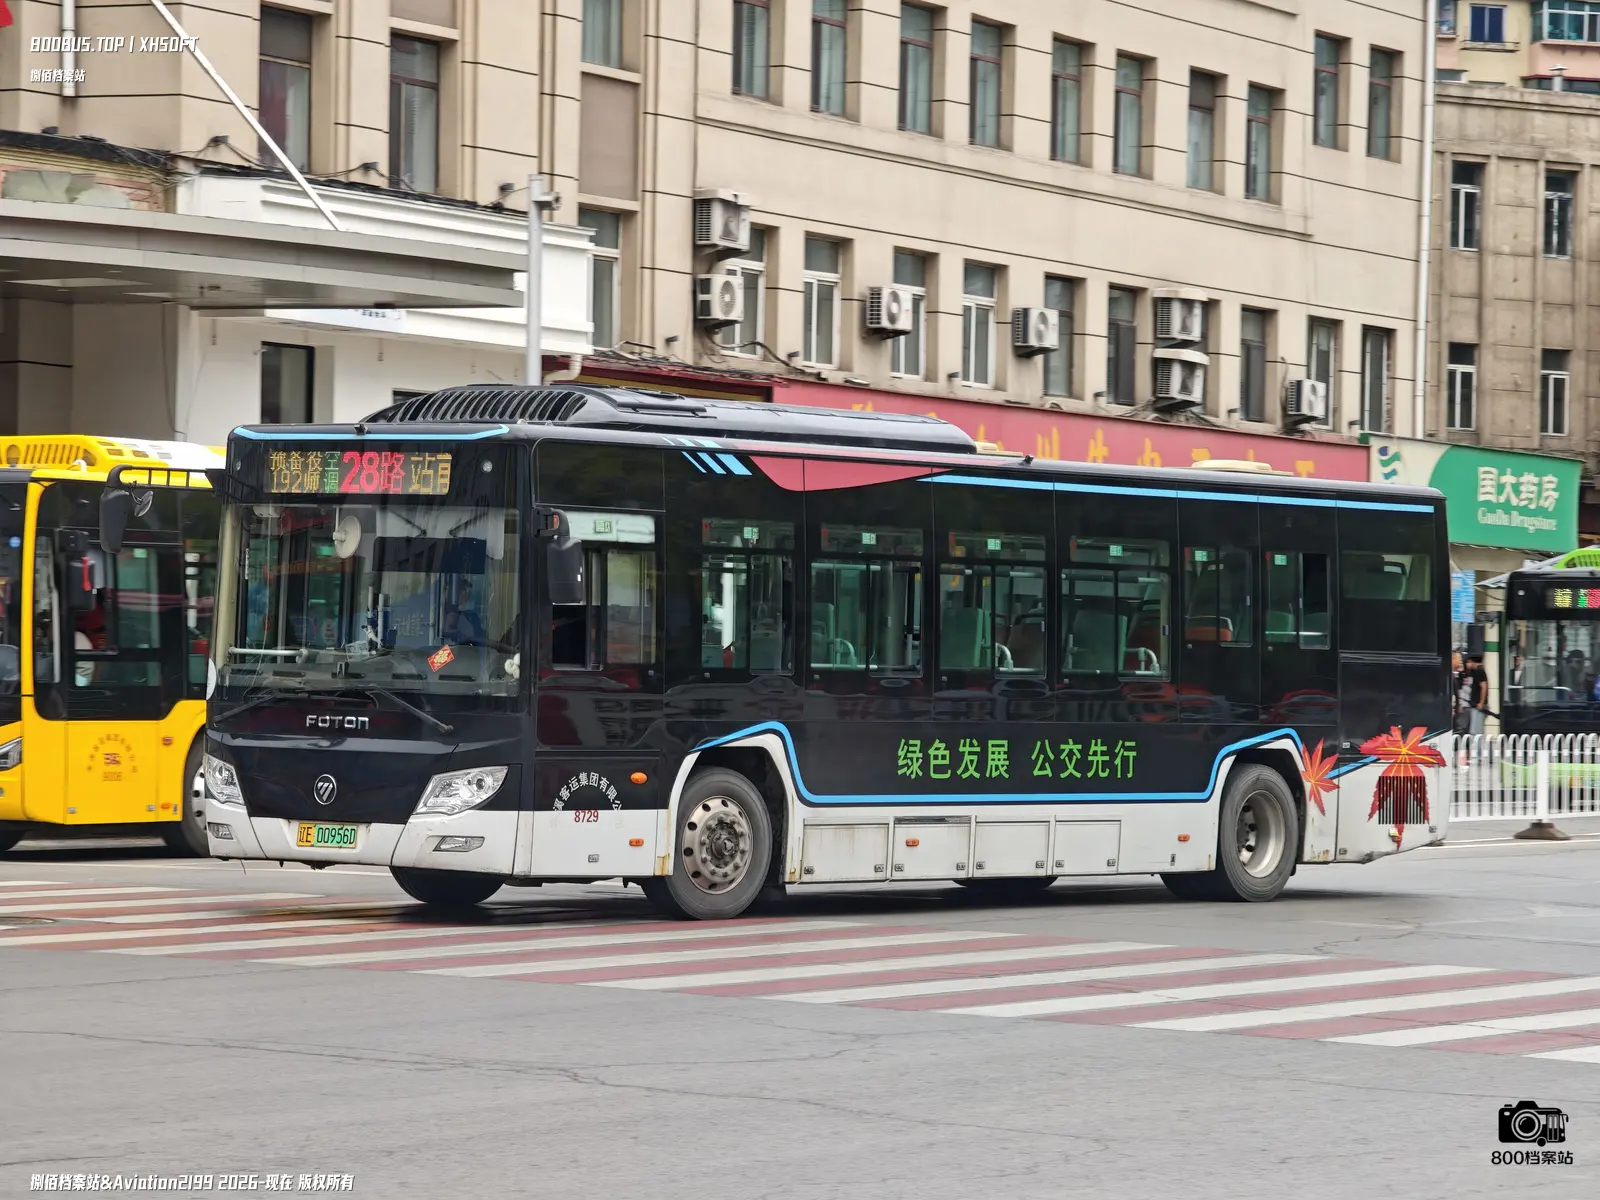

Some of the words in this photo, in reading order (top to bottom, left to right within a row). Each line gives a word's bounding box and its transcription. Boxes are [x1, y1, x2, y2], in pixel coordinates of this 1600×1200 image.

[270, 451, 323, 471] 预备役
[270, 470, 321, 493] 192师
[323, 451, 340, 493] 空调
[340, 451, 406, 494] 28路
[1478, 466, 1560, 512] 国大药房
[897, 738, 1010, 779] 绿色发展
[1031, 738, 1137, 779] 公交先行
[550, 772, 623, 822] 溪客运集团有限公
[574, 809, 599, 823] 8729
[299, 826, 312, 843] 辽E
[316, 827, 356, 844] 00956D
